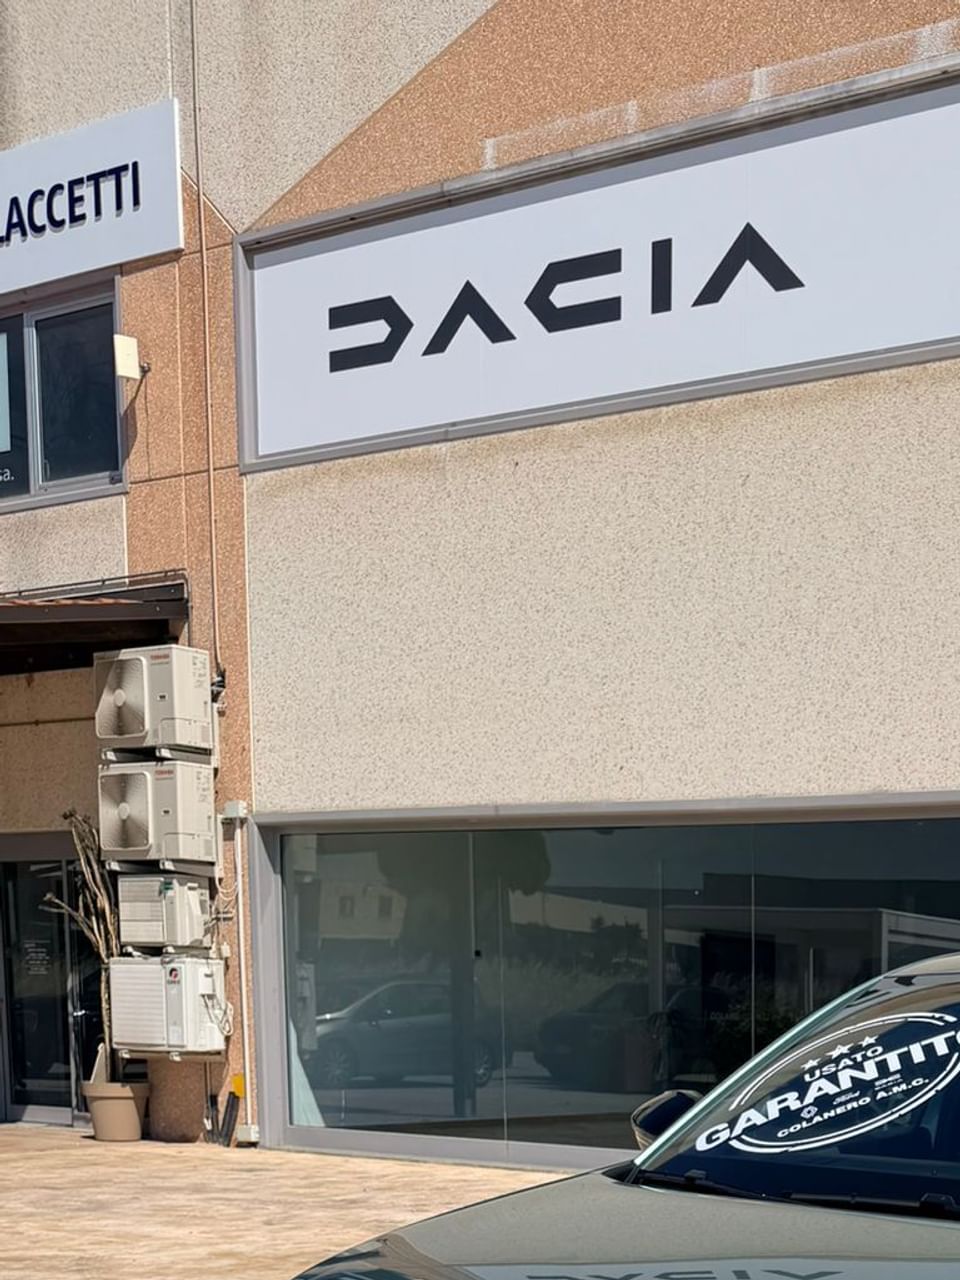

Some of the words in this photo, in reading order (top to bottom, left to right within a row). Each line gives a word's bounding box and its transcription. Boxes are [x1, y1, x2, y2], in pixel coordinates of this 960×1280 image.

[0, 160, 140, 245] ACCETTI
[328, 221, 806, 373] DACIA
[803, 1045, 884, 1082] USATO
[776, 1097, 871, 1138] COLANERO
[876, 1077, 930, 1101] A.M.C.
